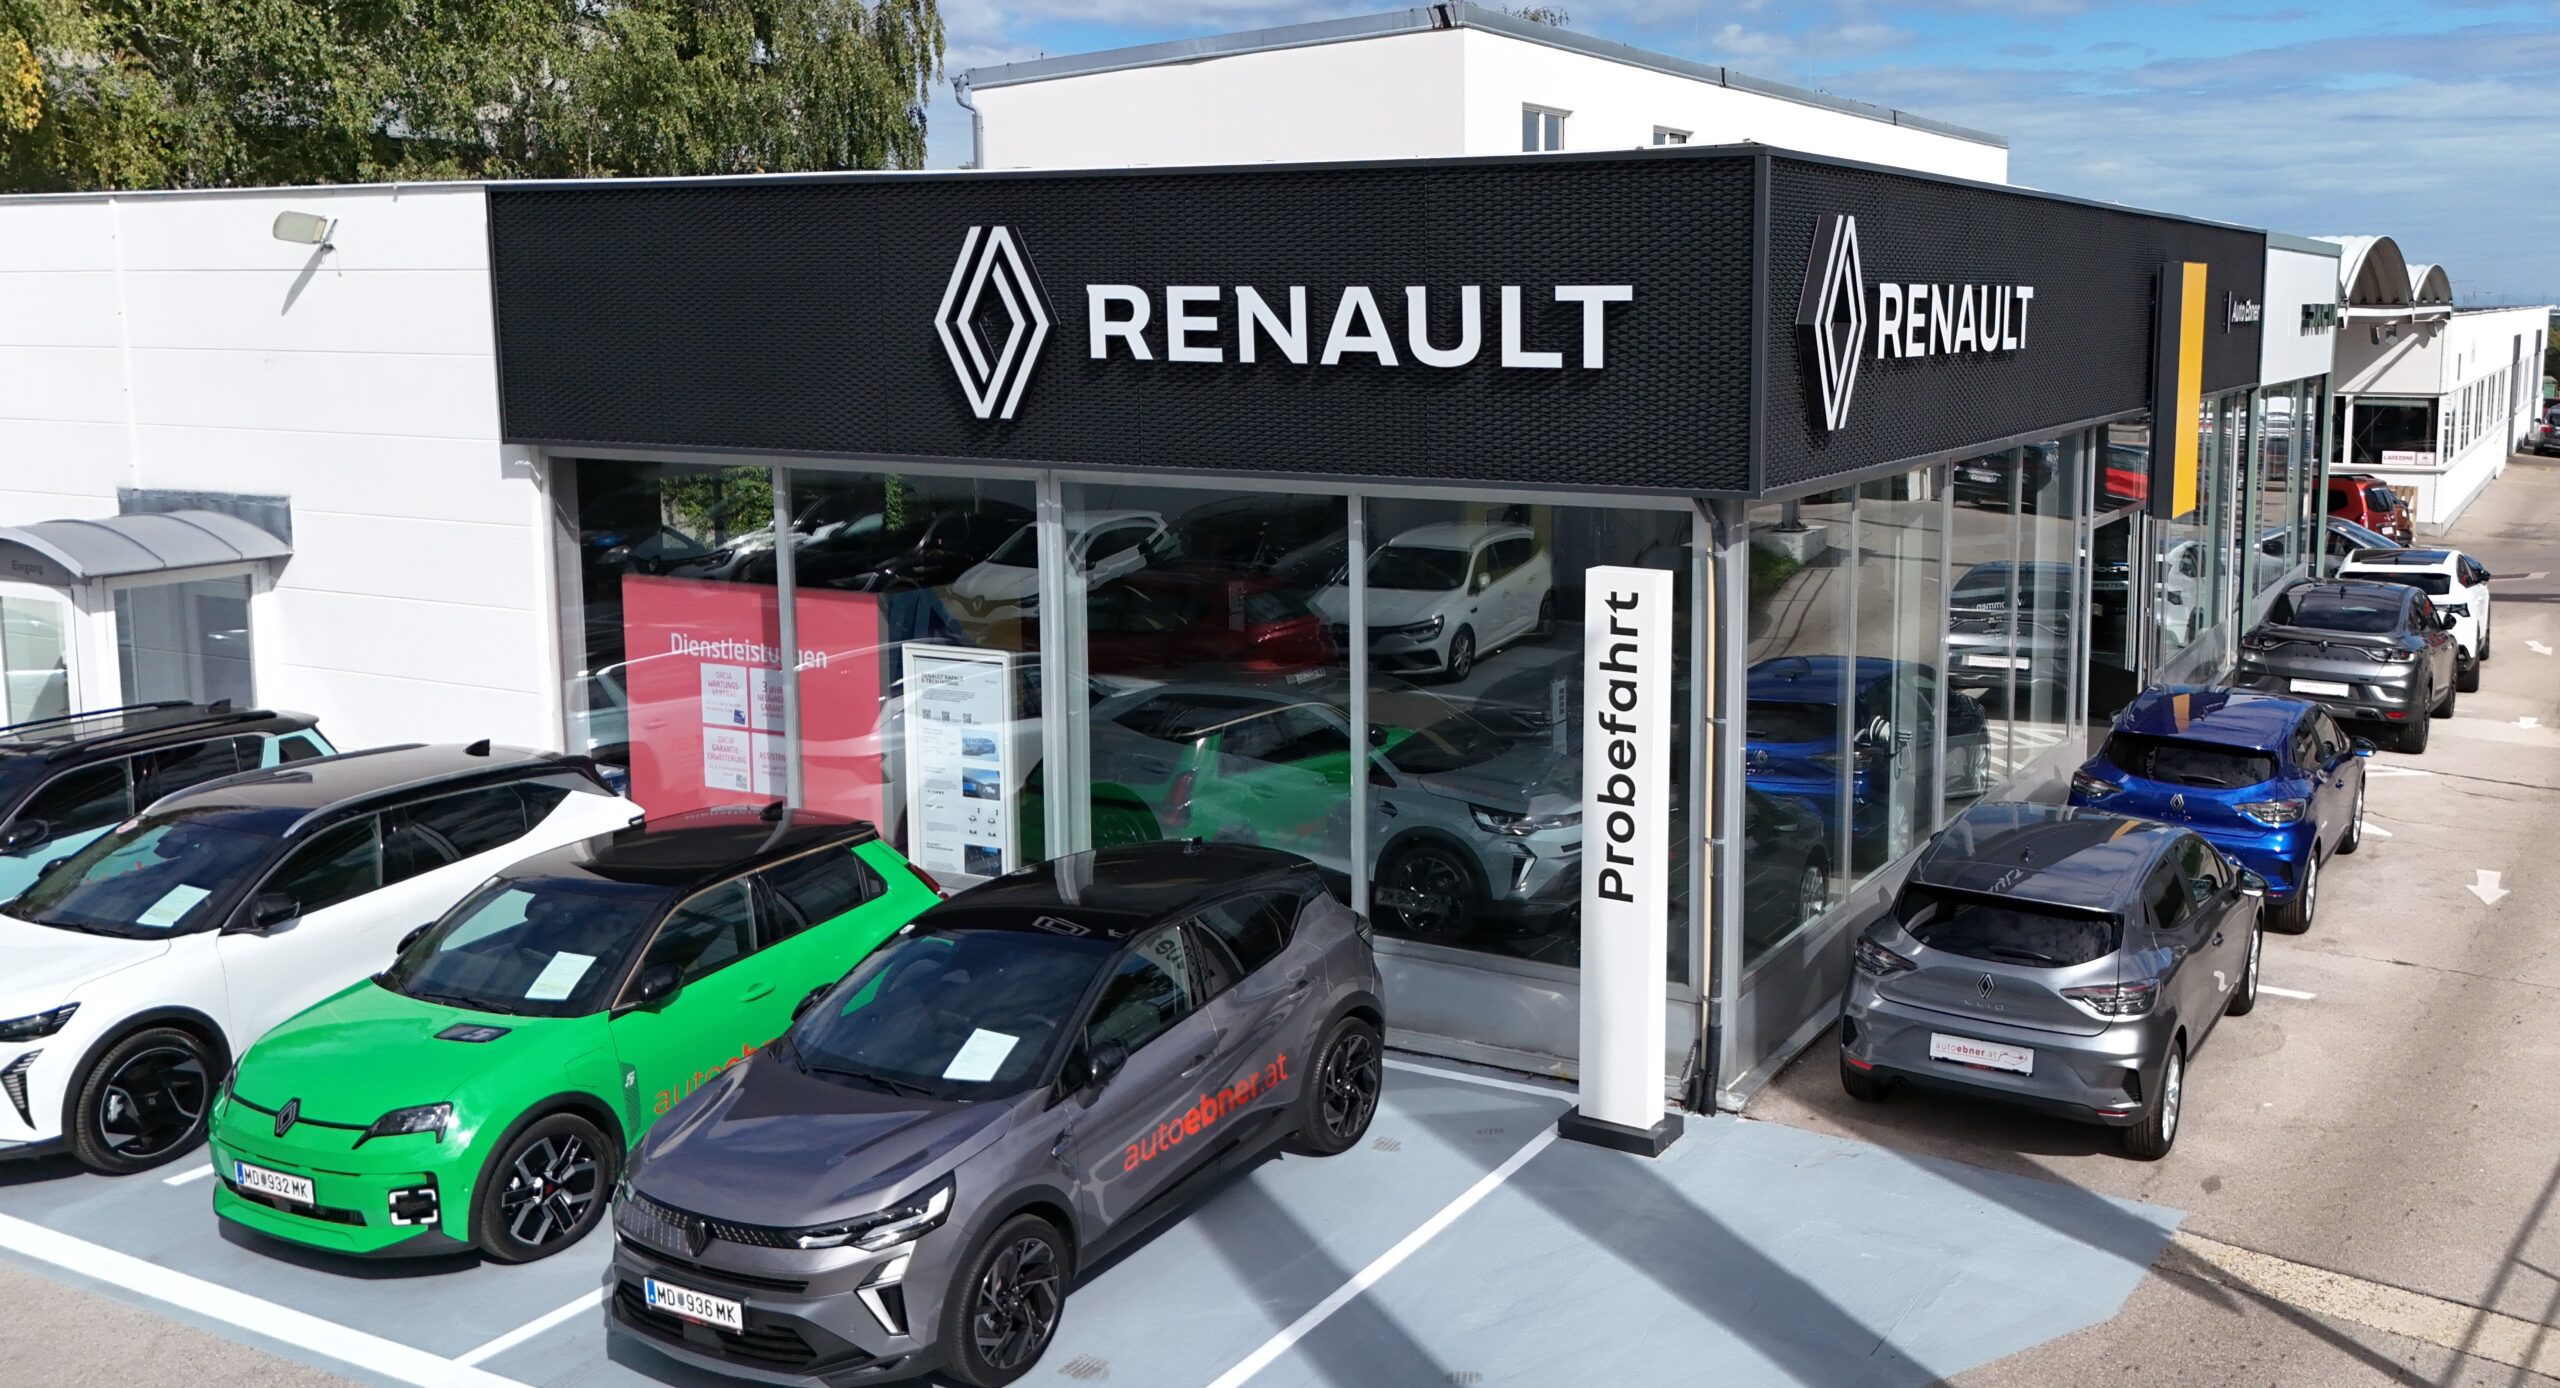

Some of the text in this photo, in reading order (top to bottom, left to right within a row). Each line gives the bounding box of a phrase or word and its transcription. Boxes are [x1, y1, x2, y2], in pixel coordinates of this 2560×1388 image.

[1086, 284, 1634, 369] RENAULT
[1877, 282, 2034, 359] RENAULT
[2231, 300, 2245, 323] Auto
[670, 633, 828, 669] Dienstleistuen
[762, 681, 768, 693] 3
[1597, 591, 1639, 903] Probefahrt
[1964, 999, 2005, 1012] CLIO
[1935, 1041, 1997, 1059] autoebner.at
[1123, 1052, 1289, 1172] autoebner.at
[244, 1167, 309, 1199] MD 932 MK
[656, 1285, 676, 1307] MD
[686, 1293, 714, 1318] 936
[715, 1301, 736, 1324] MK
